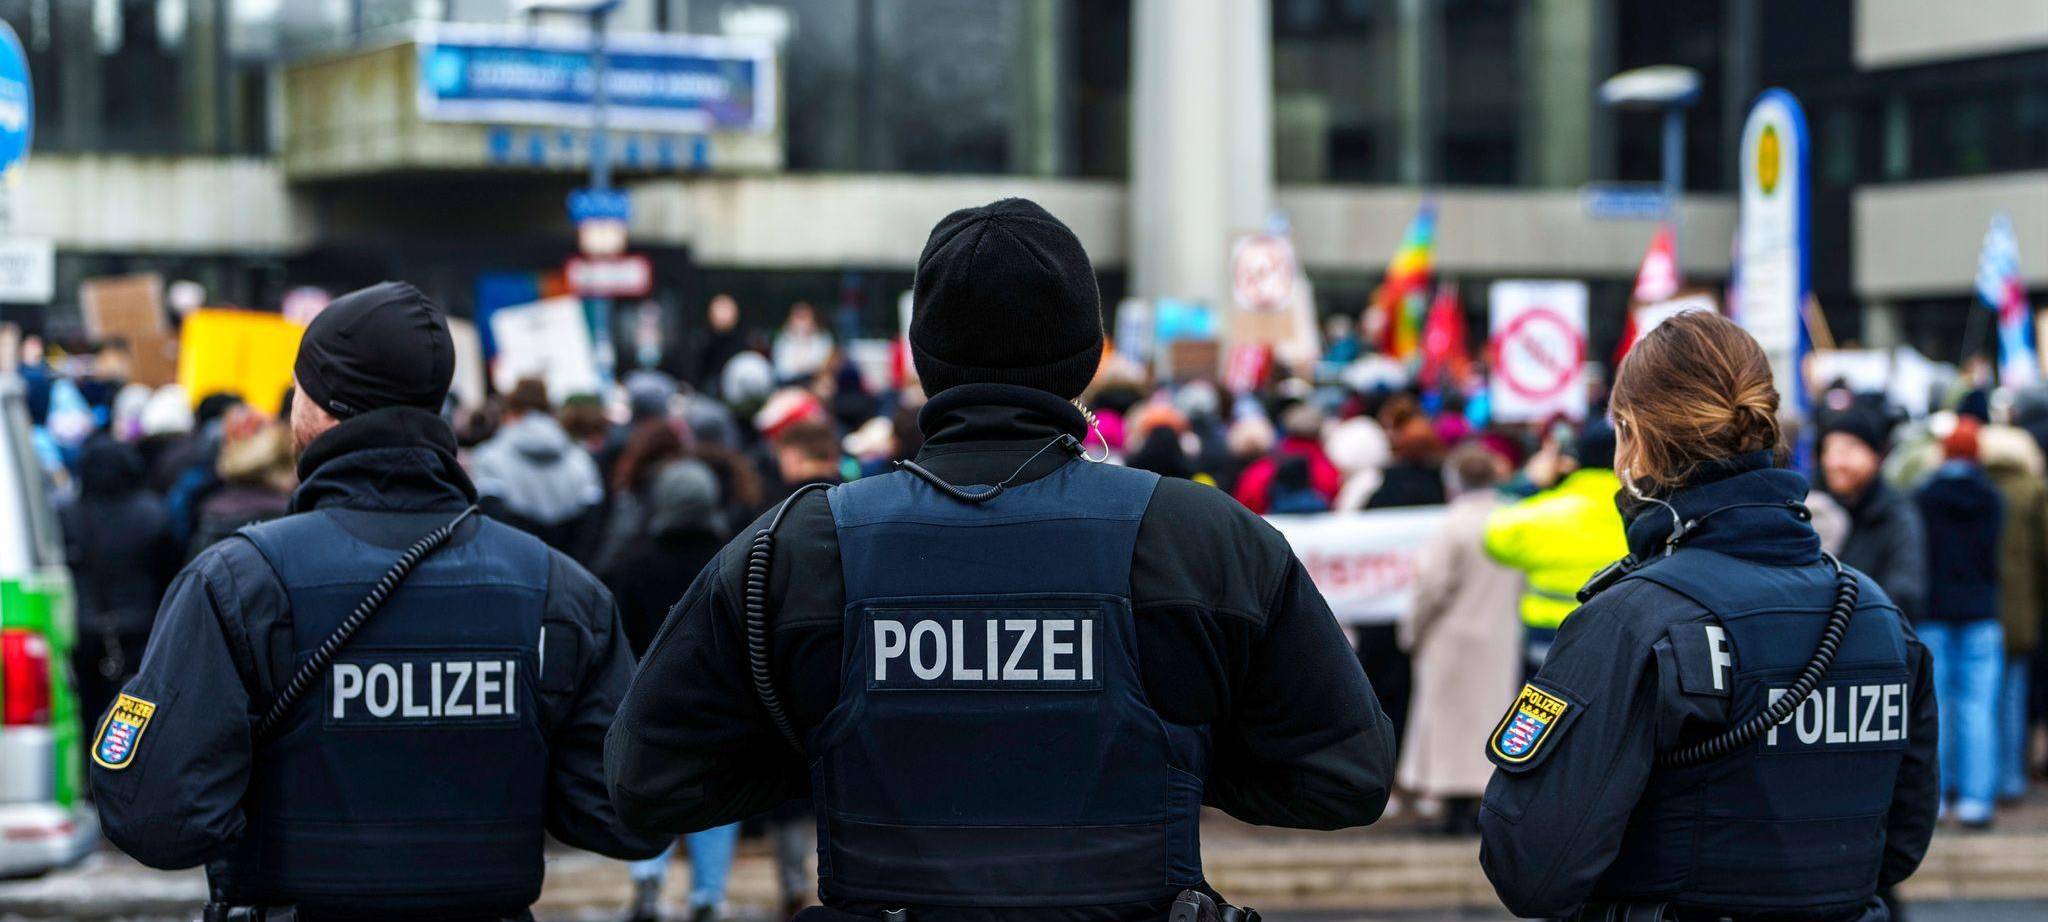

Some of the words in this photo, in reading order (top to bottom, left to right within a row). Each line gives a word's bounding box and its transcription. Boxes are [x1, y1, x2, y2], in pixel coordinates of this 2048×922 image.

[873, 619, 1094, 681] POLIZEI
[333, 660, 515, 719] POLIZEI
[1523, 687, 1564, 715] POLIZEI
[1766, 683, 1908, 746] POLIZEI
